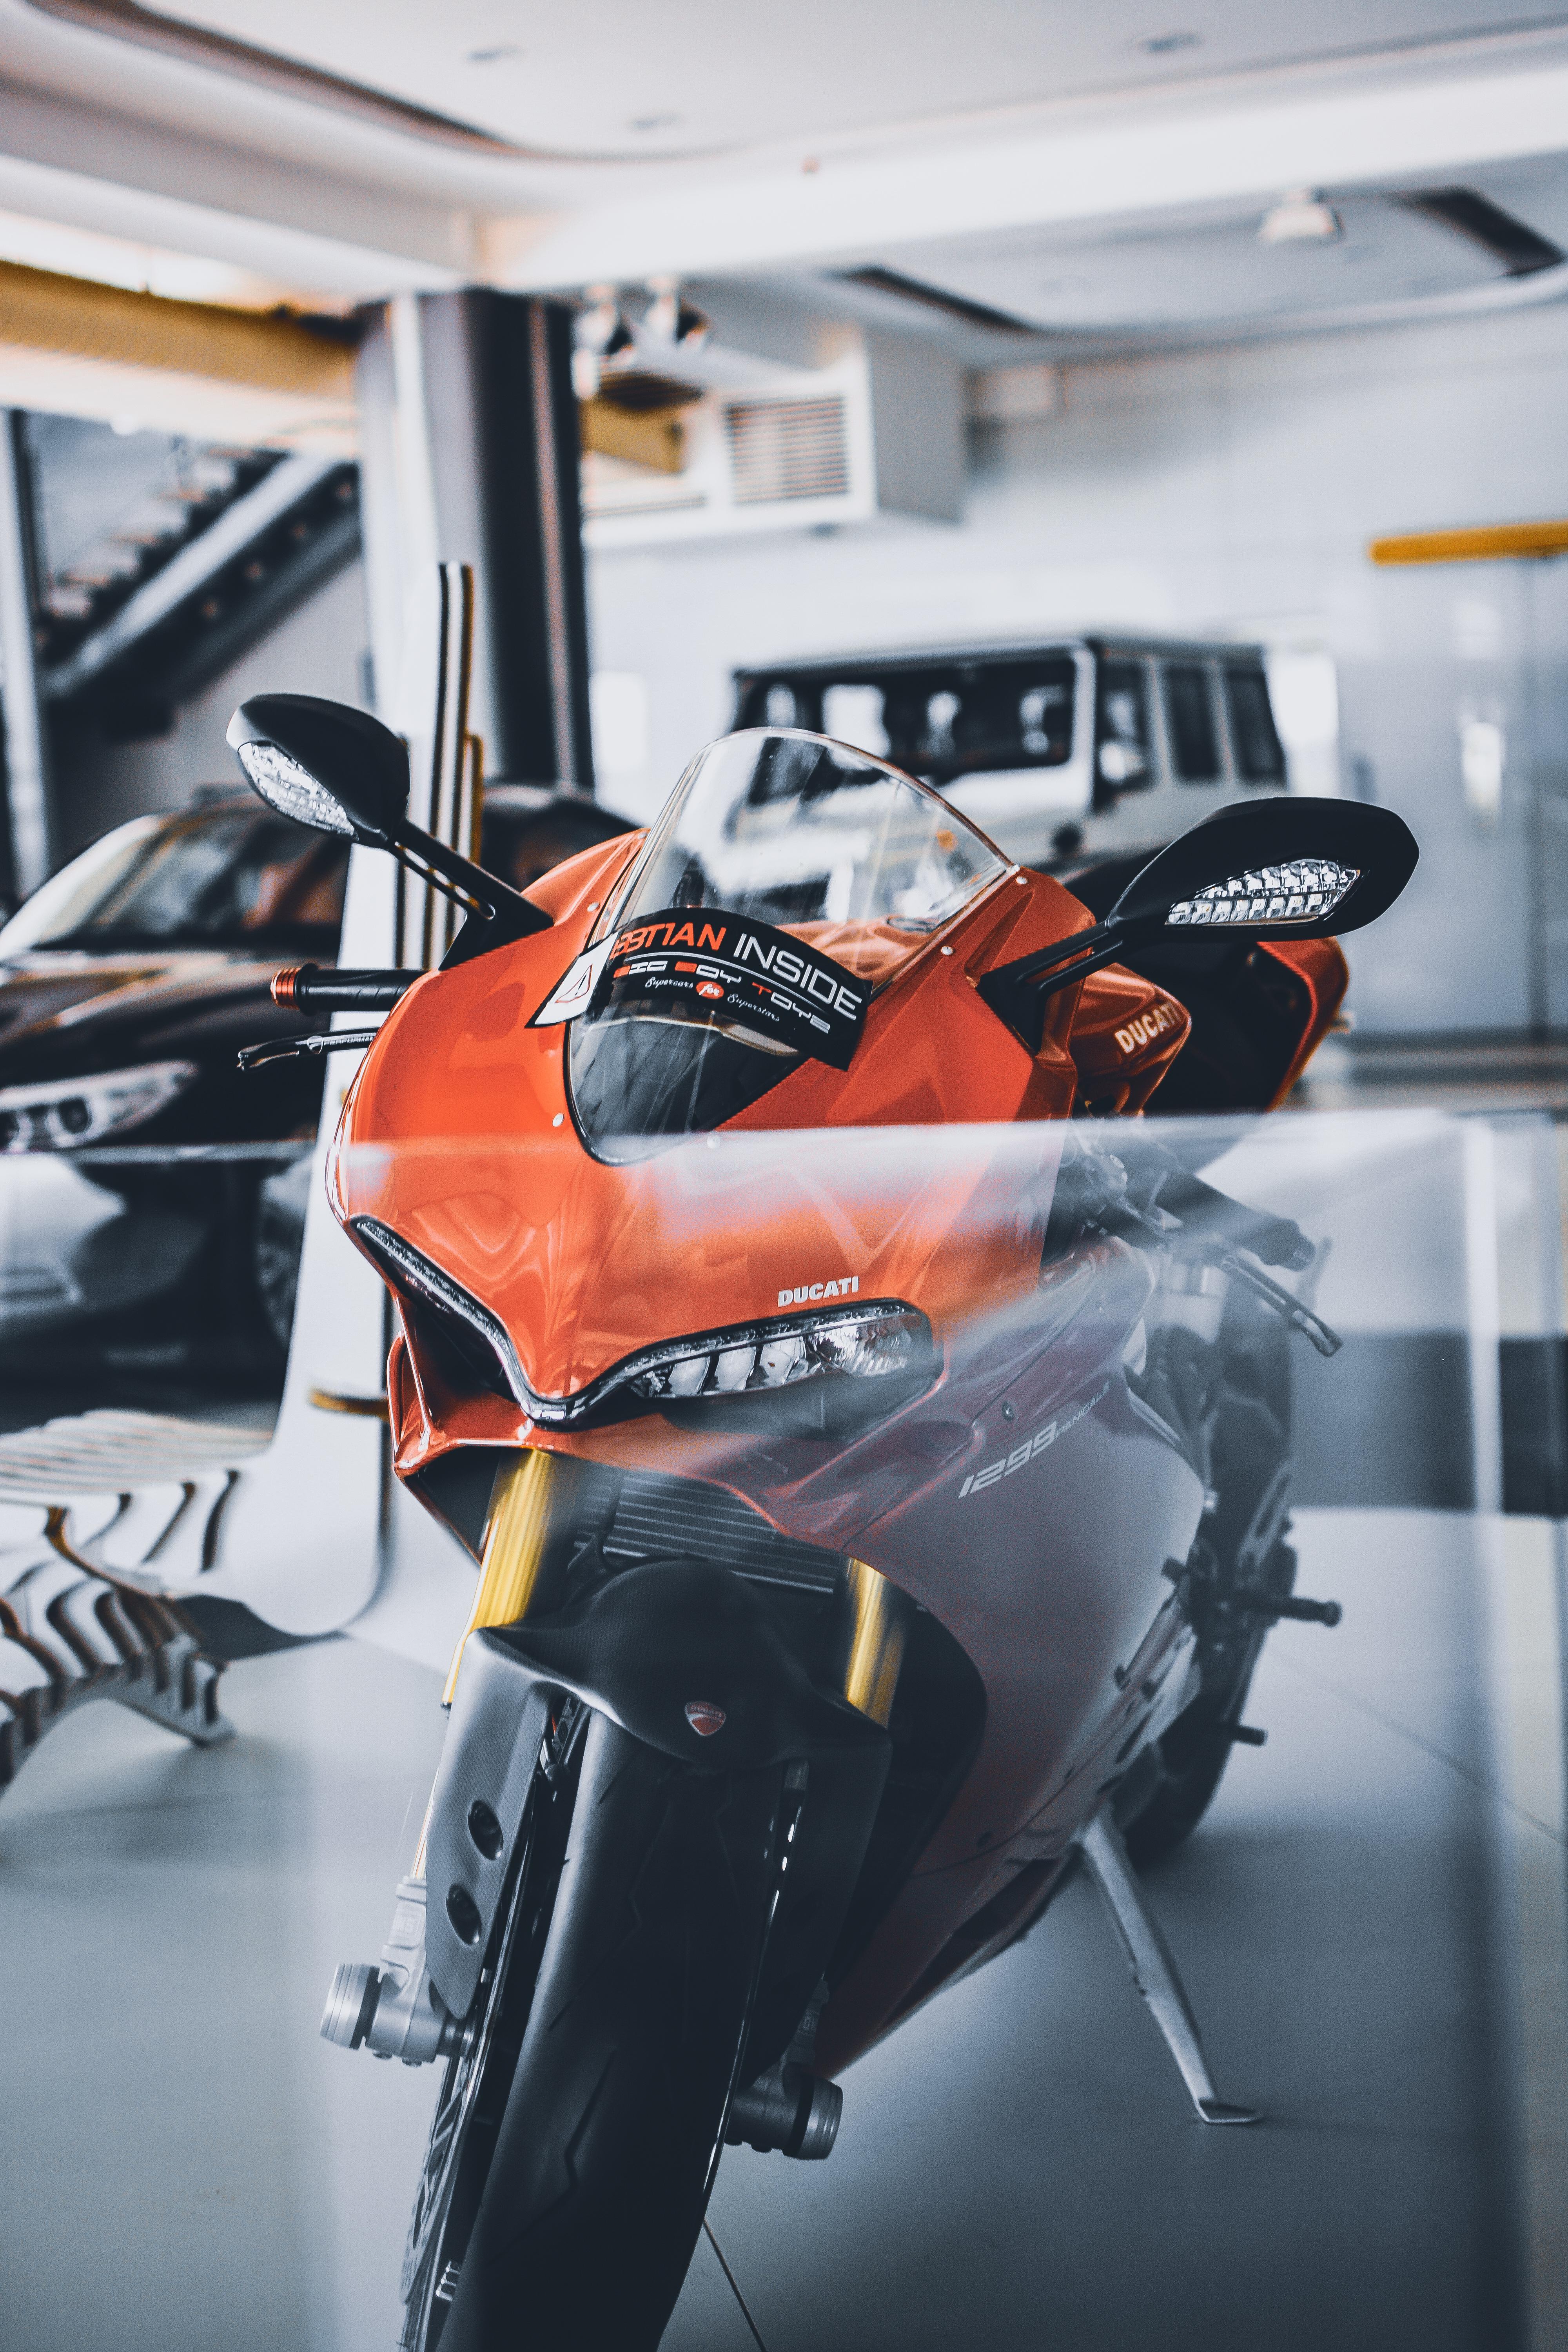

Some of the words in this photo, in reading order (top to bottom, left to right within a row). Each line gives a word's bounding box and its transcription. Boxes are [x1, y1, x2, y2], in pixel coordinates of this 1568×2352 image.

[699, 983, 720, 996] for
[733, 933, 862, 1020] INSIDE
[1114, 1001, 1180, 1054] DUCATI
[777, 1276, 859, 1308] DUCATI
[958, 1421, 1057, 1499] 1299
